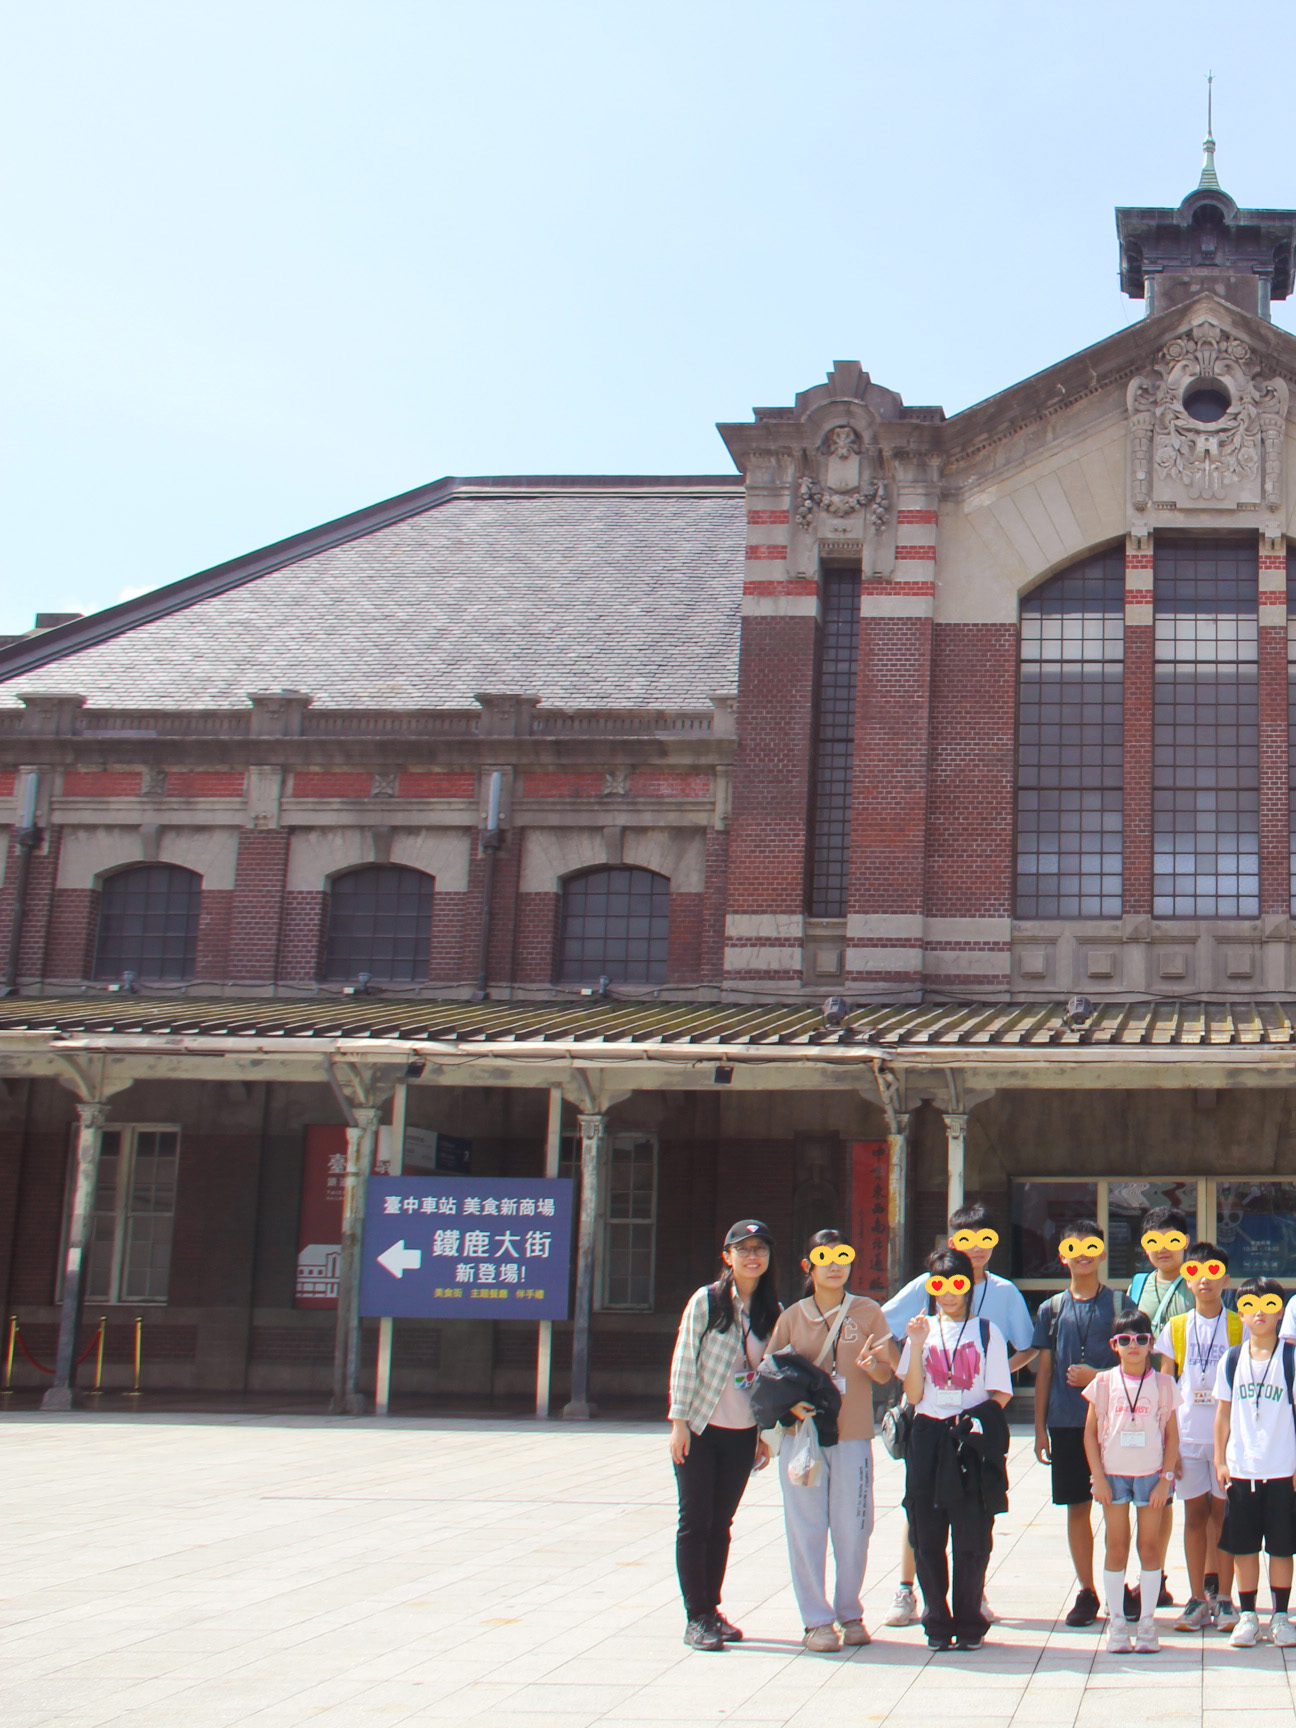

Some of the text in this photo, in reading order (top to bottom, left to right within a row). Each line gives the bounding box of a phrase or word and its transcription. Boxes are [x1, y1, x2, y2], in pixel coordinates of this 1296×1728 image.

[384, 1196, 556, 1217] 臺中車站 美食新商場
[432, 1229, 552, 1258] 鐵鹿大街
[455, 1263, 526, 1283] 新登場!
[1237, 1381, 1284, 1402] OSTON
